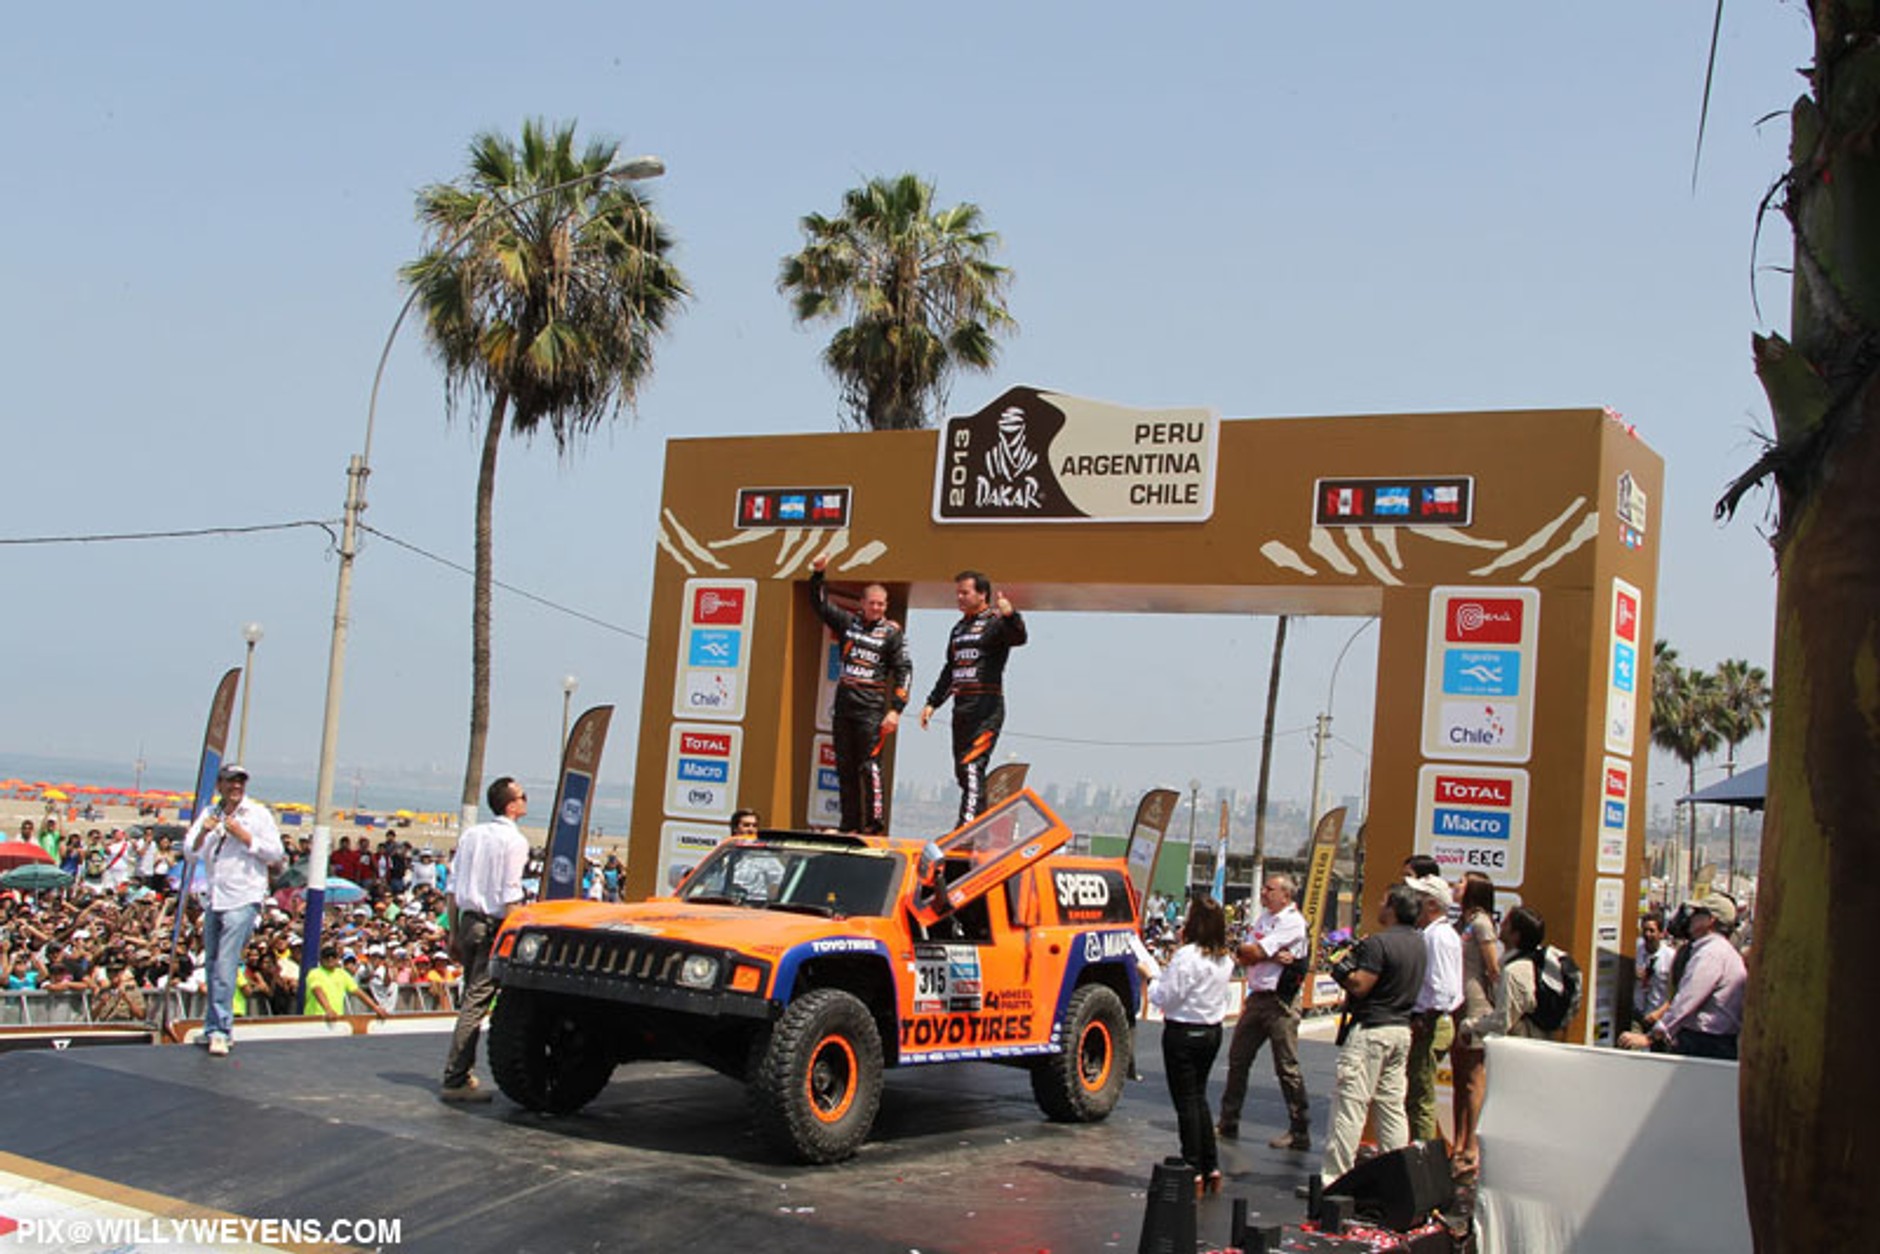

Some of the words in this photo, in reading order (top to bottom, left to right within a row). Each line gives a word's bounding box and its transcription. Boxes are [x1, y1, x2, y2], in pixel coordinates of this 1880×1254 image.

[1135, 422, 1204, 444] PERU
[949, 429, 970, 506] 2013
[1060, 453, 1201, 476] ARGENTINA
[976, 475, 1041, 508] DAKAR
[1130, 484, 1199, 505] CHILE
[691, 692, 720, 706] Chile
[684, 736, 727, 751] TOTAL
[1449, 726, 1494, 743] Chile
[684, 763, 723, 778] Macro
[1441, 782, 1505, 800] TOTAL
[1443, 813, 1501, 833] Macro
[1056, 873, 1109, 906] SPEED
[919, 966, 946, 994] 315
